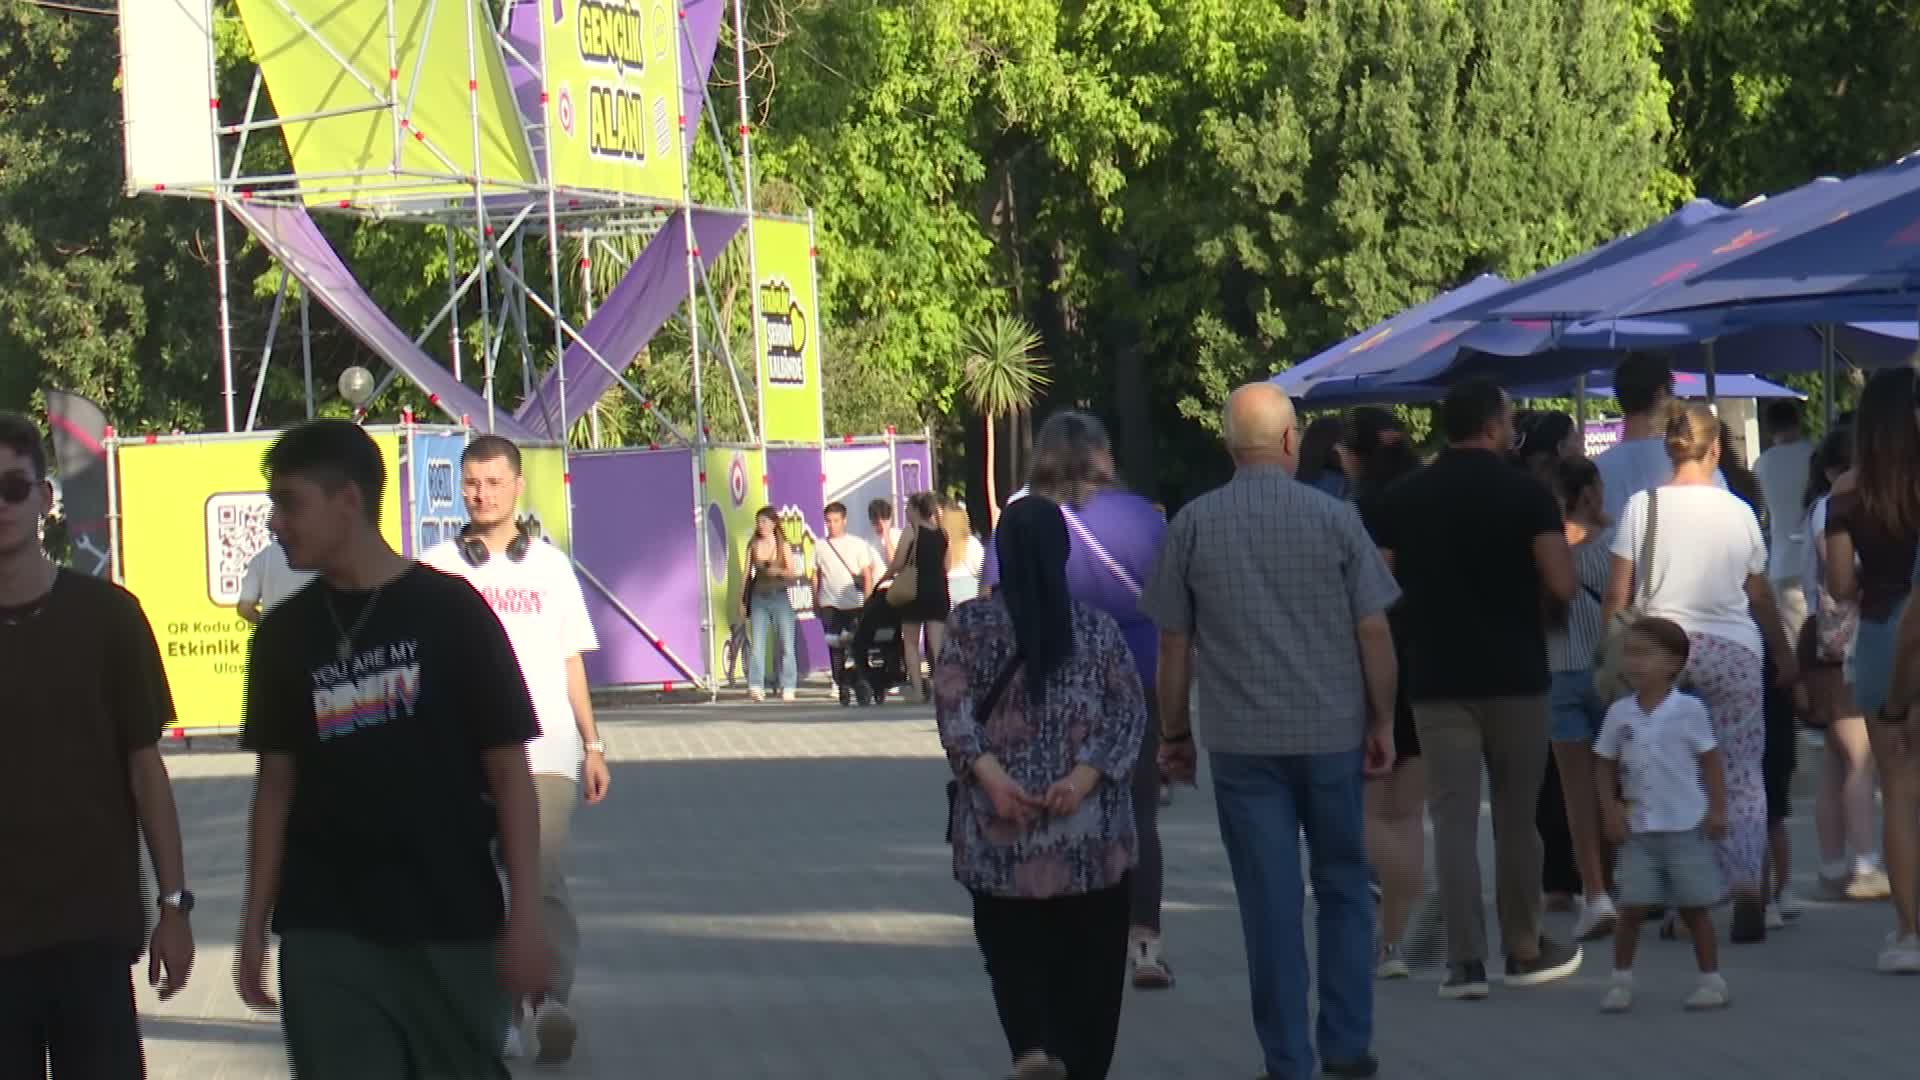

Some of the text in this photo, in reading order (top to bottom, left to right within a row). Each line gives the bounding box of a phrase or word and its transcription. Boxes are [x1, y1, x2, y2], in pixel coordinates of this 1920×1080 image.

[590, 85, 645, 160] ALANI
[168, 622, 188, 635] QR
[193, 621, 230, 633] Kodu
[168, 640, 240, 657] Etkinlik
[311, 637, 418, 688] YOU ARE MY
